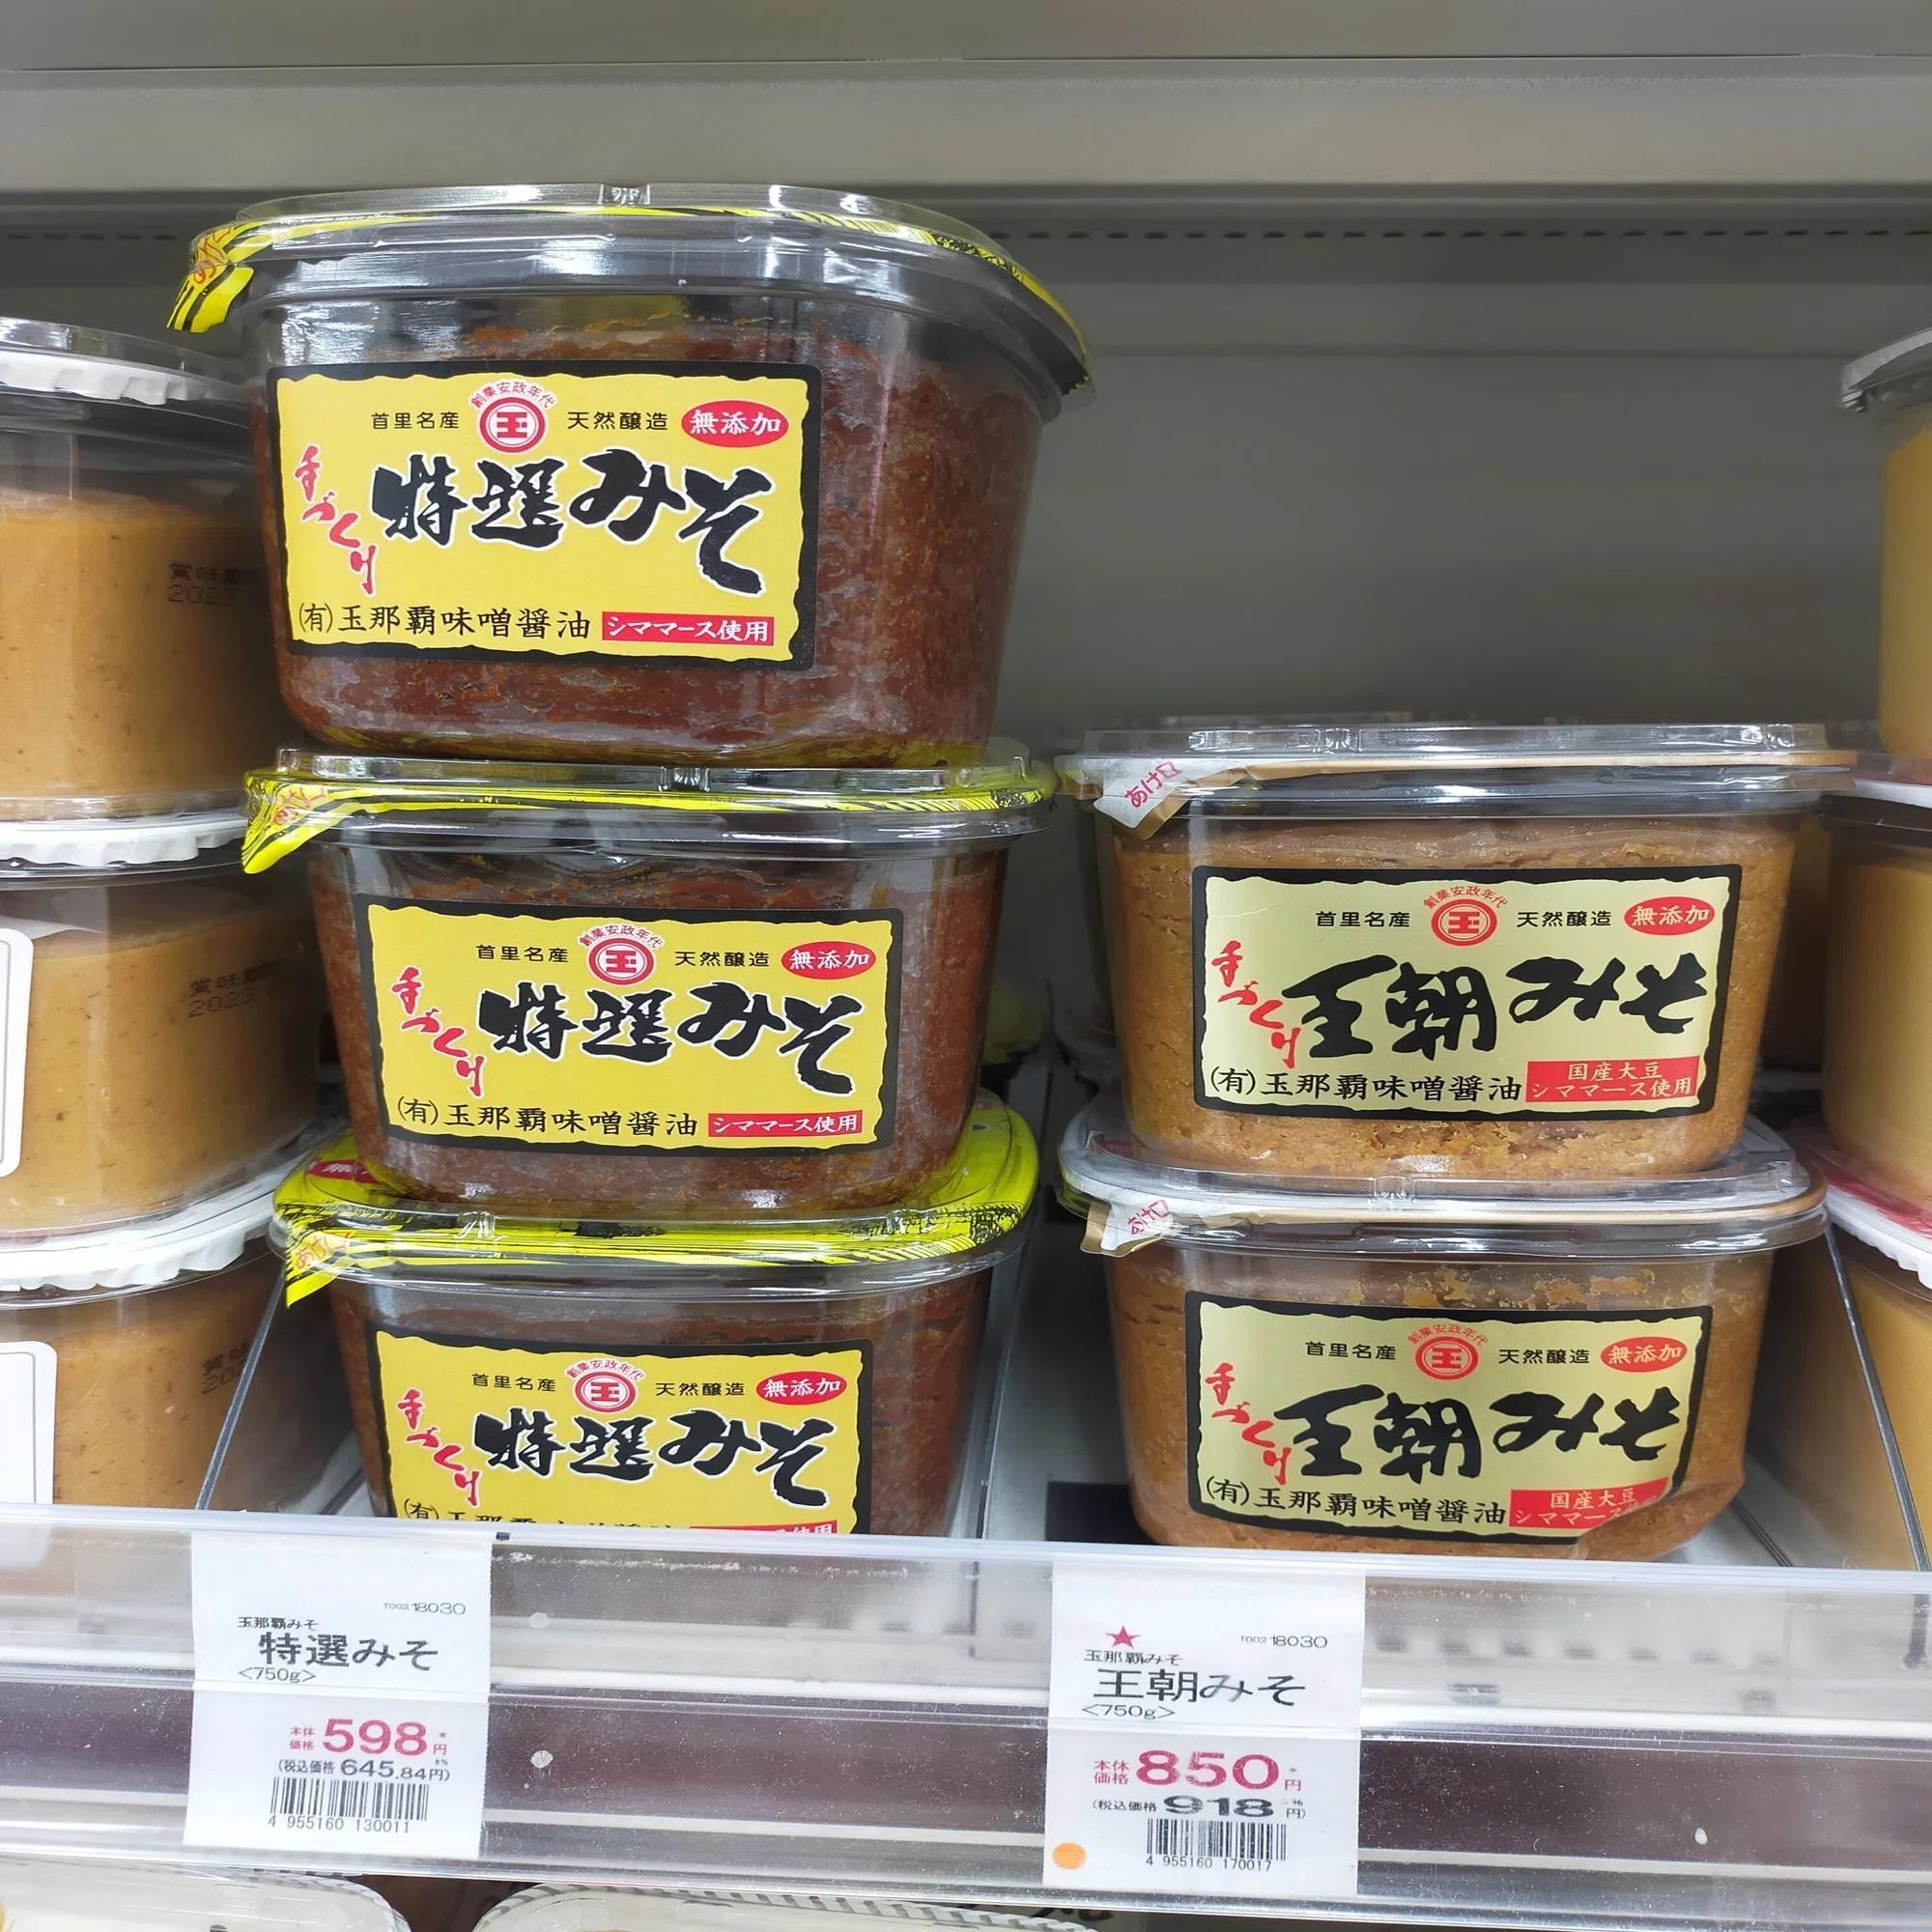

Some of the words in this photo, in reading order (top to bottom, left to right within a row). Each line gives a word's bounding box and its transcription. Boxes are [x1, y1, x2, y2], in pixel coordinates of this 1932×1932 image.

[470, 379, 556, 410] 創業安政年代
[371, 412, 460, 431] 首里名産
[568, 412, 668, 432] 天然醸造
[689, 411, 782, 436] 無添加
[296, 444, 375, 595] 手づくり
[371, 448, 773, 597] 特選みそ
[607, 615, 770, 641] シママース使用
[1124, 761, 1181, 808] あけ口
[1423, 885, 1509, 909] 創業安政年代
[1316, 910, 1410, 928] 首里名産
[1517, 910, 1612, 928] 天然醸造
[1631, 905, 1710, 925] 無添加
[580, 924, 663, 949] 創業安政年代
[476, 945, 569, 964] 首里名産
[675, 951, 770, 968] 天然醸造
[788, 950, 870, 971] 無添加
[1211, 940, 1302, 1068] 手づくり
[1282, 952, 1708, 1061] 王朝みそ
[392, 967, 484, 1097] 手づくり
[478, 981, 863, 1094] 特選みそ
[1568, 1061, 1662, 1081] 国産大豆
[1531, 1076, 1691, 1099] シママース使用
[712, 1114, 858, 1135] シママース使用
[1126, 1199, 1171, 1235] あけ口
[1305, 1341, 1397, 1360] 首里名産
[1498, 1349, 1590, 1365] 天然醸造
[1607, 1344, 1689, 1365] 無添加
[472, 1373, 556, 1393] 首里名産
[655, 1382, 746, 1397] 天然醸造
[763, 1378, 841, 1398] 無添加
[1205, 1362, 1293, 1486] 手づくり
[1273, 1385, 1681, 1485] 王朝みそ
[396, 1389, 480, 1507] 手づくり
[473, 1408, 838, 1507] 特選みそ
[1550, 1488, 1636, 1509] 国産大豆
[237, 1616, 320, 1631] 玉那覇みそ
[258, 1632, 439, 1671] 特選みそ
[1084, 1649, 1183, 1666] 玉那覇みそ
[1093, 1668, 1306, 1706] 王朝みそ
[290, 1725, 316, 1738] 本体
[323, 1719, 427, 1756] 598
[433, 1744, 447, 1755] 円
[290, 1740, 315, 1751] 価格
[1094, 1760, 1129, 1772] 本体
[1136, 1749, 1279, 1790] 850
[1285, 1778, 1301, 1791] 円
[1094, 1773, 1129, 1784] 価格
[1163, 1795, 1274, 1817] 918
[268, 1815, 276, 1828] 4
[287, 1815, 344, 1831] 955160
[355, 1819, 410, 1833] 130011
[1146, 1855, 1153, 1866] 4
[1162, 1856, 1212, 1868] 955160
[1222, 1859, 1272, 1871] 170017
